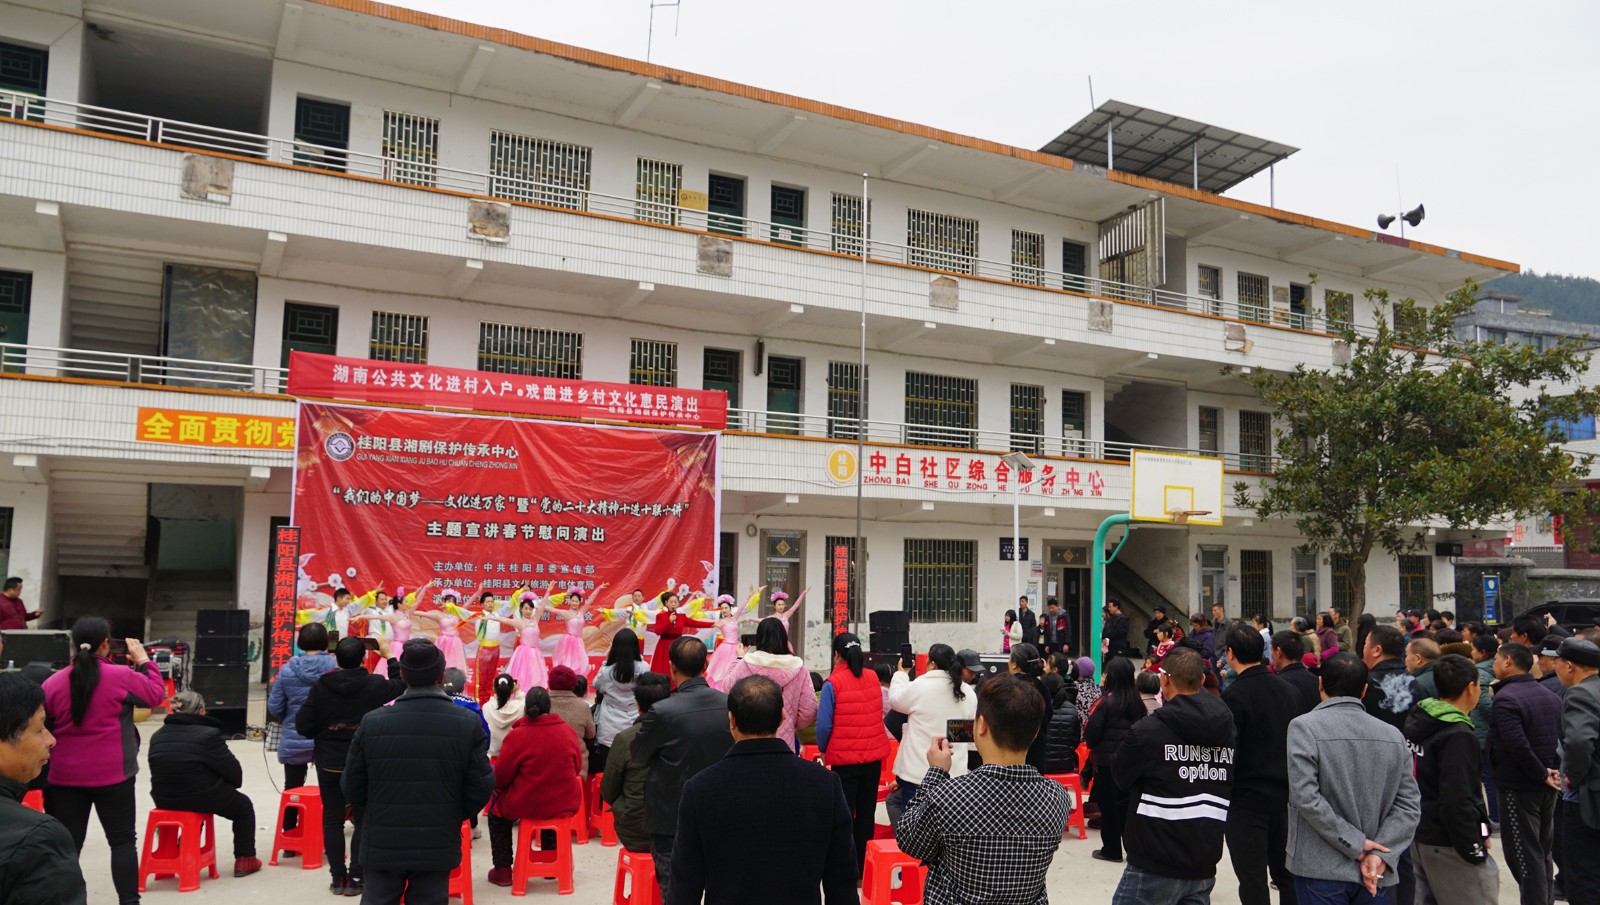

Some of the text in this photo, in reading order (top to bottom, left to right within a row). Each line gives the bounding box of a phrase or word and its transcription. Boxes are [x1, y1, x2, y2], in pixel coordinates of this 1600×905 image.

[357, 435, 519, 459] 桂阳县湘剧保护传承中心
[863, 475, 892, 485] ZHONG
[895, 477, 910, 486] BAI
[923, 480, 938, 489] SHE
[966, 482, 988, 491] ZONG
[997, 484, 1007, 492] HE
[1041, 486, 1054, 495] WU
[1090, 489, 1103, 498] XIN
[426, 521, 605, 542] 主题宣讲春节慰问演出
[269, 528, 299, 684] 桂阳县湘剧保护传承中
[1164, 744, 1235, 765] RUNSTAY
[1178, 763, 1227, 783] option
